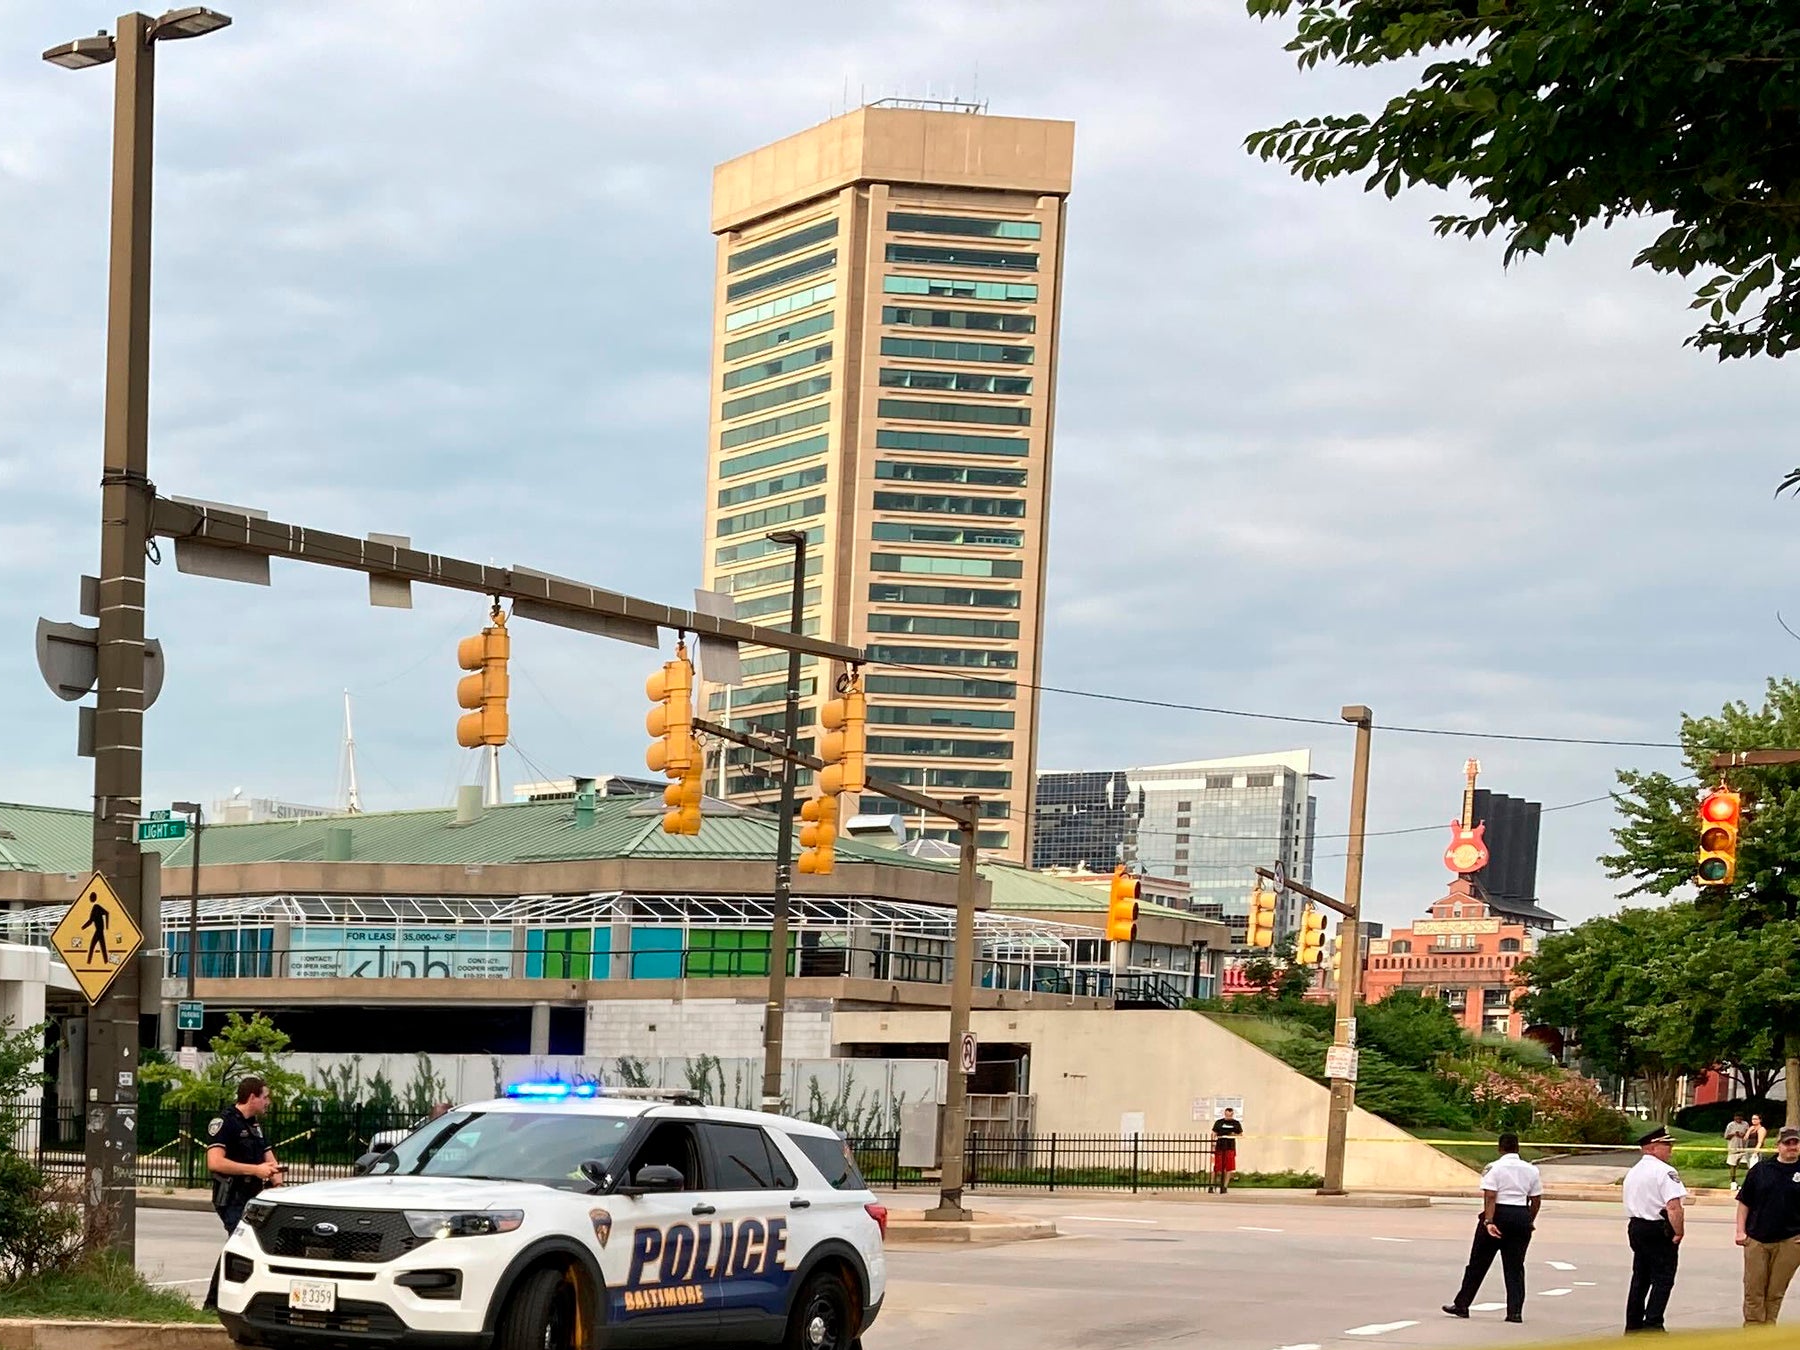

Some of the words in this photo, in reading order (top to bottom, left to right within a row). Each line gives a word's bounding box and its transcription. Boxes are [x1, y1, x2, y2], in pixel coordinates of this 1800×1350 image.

[143, 823, 169, 838] LIGHT
[346, 932, 365, 940] FOR
[444, 933, 456, 941] SF
[627, 1215, 791, 1286] POLICE
[308, 1288, 332, 1304] 3359
[624, 1284, 705, 1312] BALTIMORE
